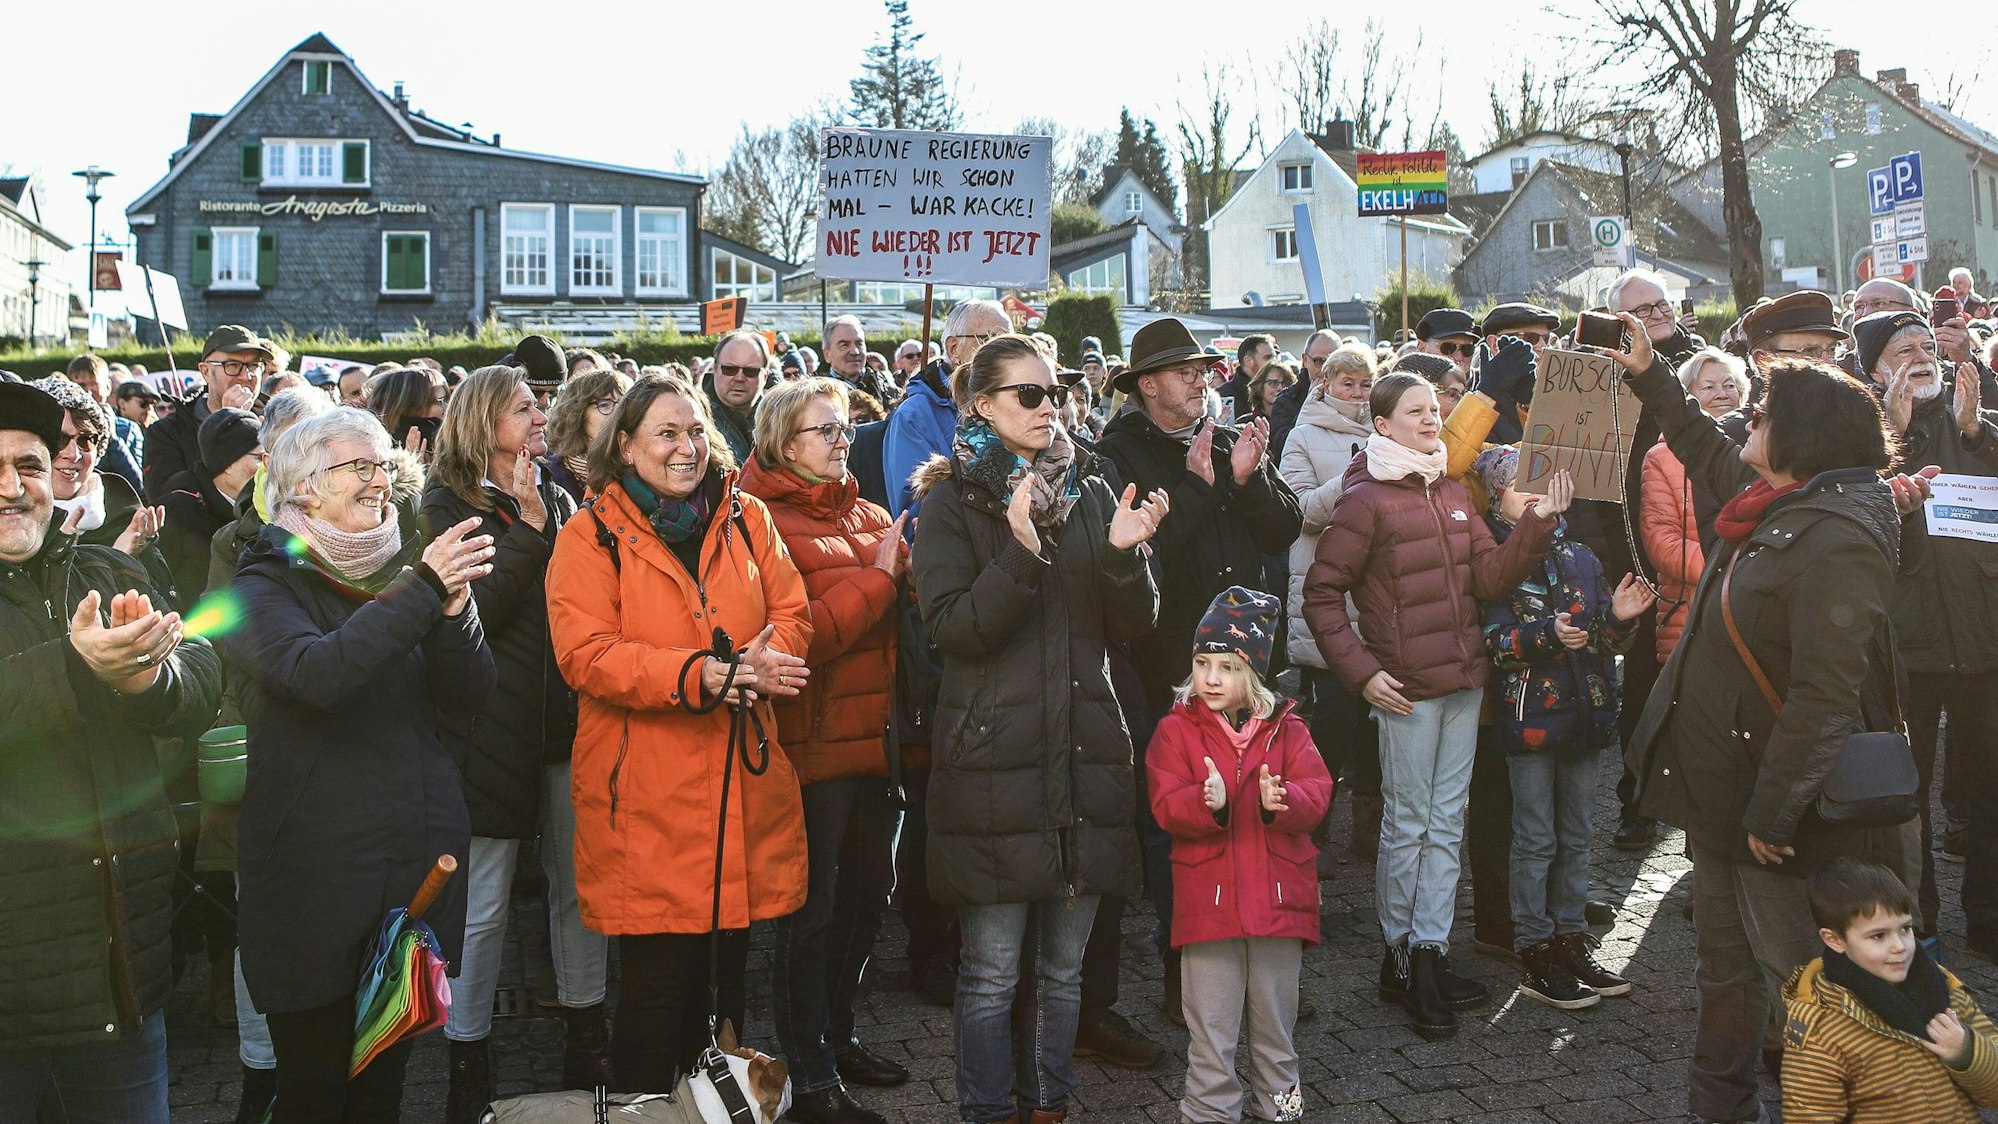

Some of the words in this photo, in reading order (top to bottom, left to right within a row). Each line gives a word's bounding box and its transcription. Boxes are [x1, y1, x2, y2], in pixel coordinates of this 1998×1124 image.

[826, 135, 912, 160] BRAUNE
[928, 138, 1031, 161] REGIERUNG
[828, 167, 897, 190] HATTEN
[913, 167, 945, 189] WIR
[960, 168, 1015, 189] SCHON
[1872, 173, 1889, 209] P
[1895, 161, 1912, 197] P
[199, 201, 261, 212] Ristorante
[261, 194, 379, 222] Aragosta
[379, 201, 427, 213] Pizzeria
[828, 197, 866, 220] MAL
[910, 195, 957, 216] WAR
[963, 197, 1034, 219] KACKE!
[1602, 225, 1614, 240] H
[826, 228, 861, 257] NIE
[871, 229, 940, 255] WIEDER
[947, 230, 973, 253] IST
[982, 230, 1041, 264] JETZT
[903, 254, 932, 277] !!!
[1893, 316, 1913, 327] MOIN
[1574, 411, 1593, 426] IST
[1526, 424, 1633, 488] BUNT
[1949, 507, 1979, 515] WIEDER
